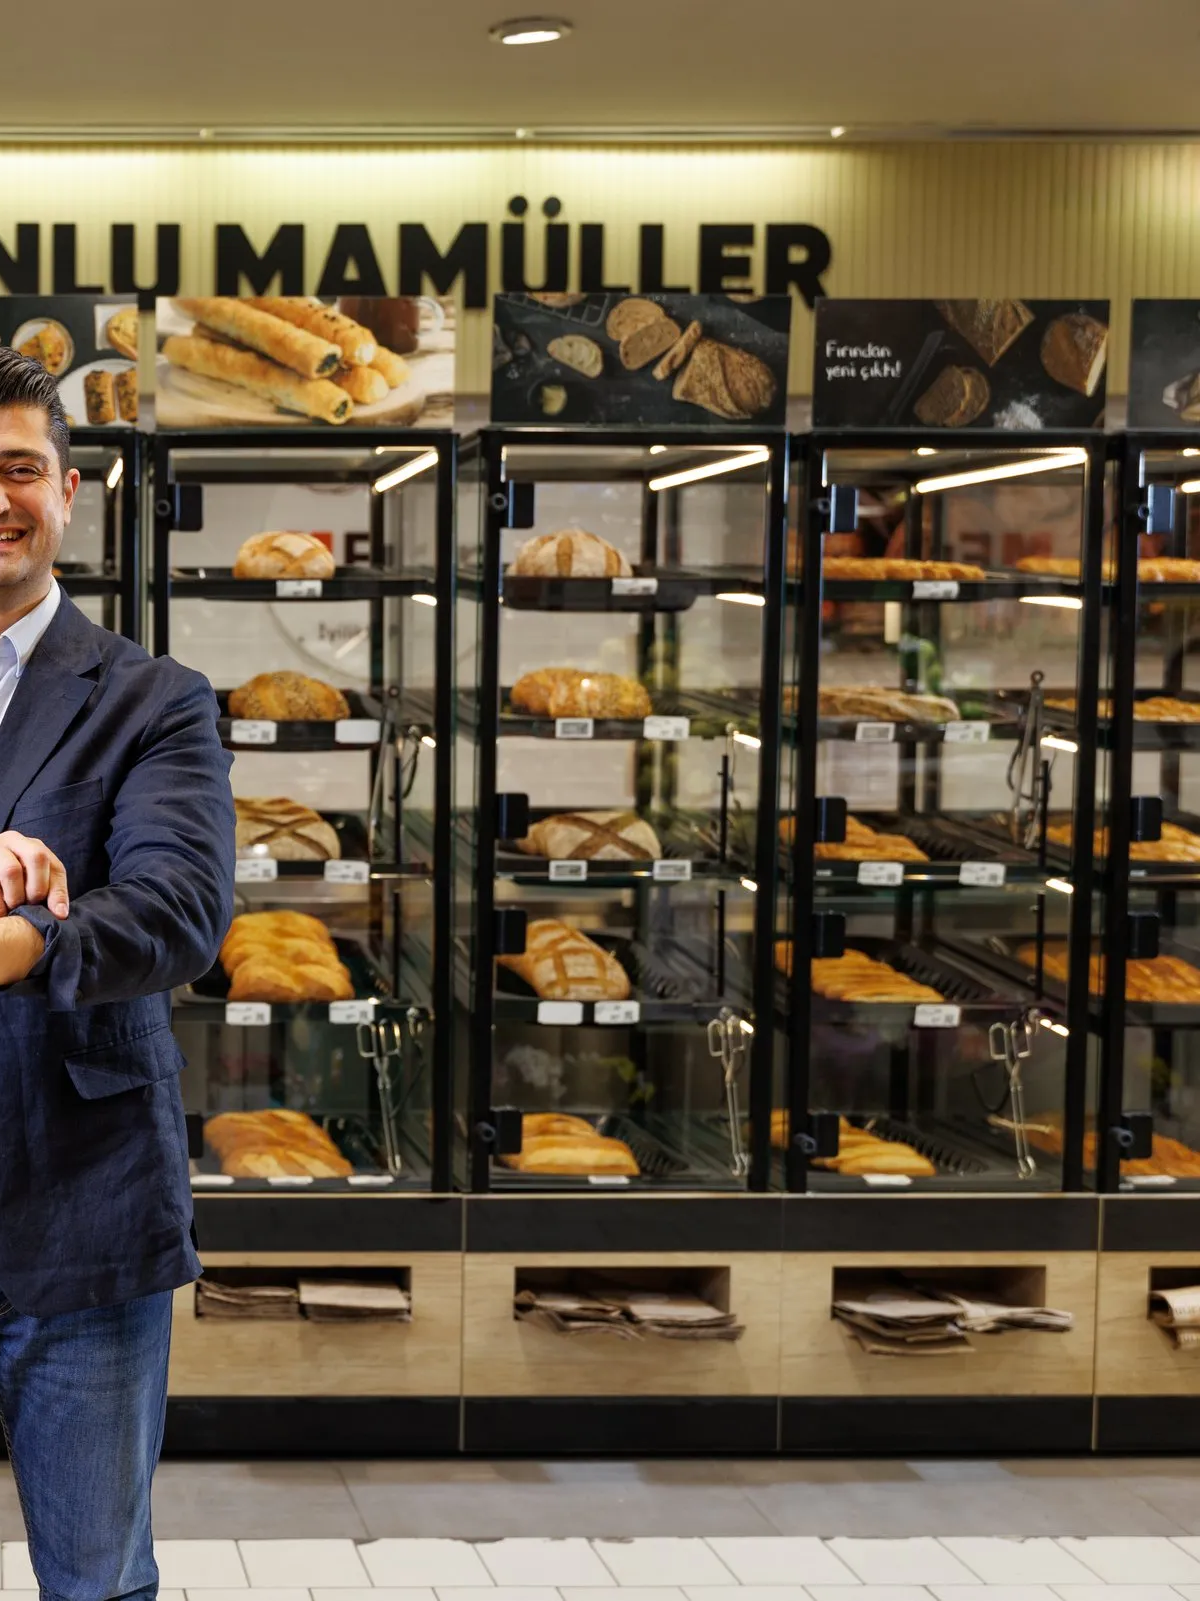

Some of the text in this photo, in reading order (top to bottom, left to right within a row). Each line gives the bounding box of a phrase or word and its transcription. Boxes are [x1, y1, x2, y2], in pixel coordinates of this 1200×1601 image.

[214, 195, 832, 310] MAMÜLLER
[825, 340, 892, 358] Fırından
[825, 361, 856, 381] yeni
